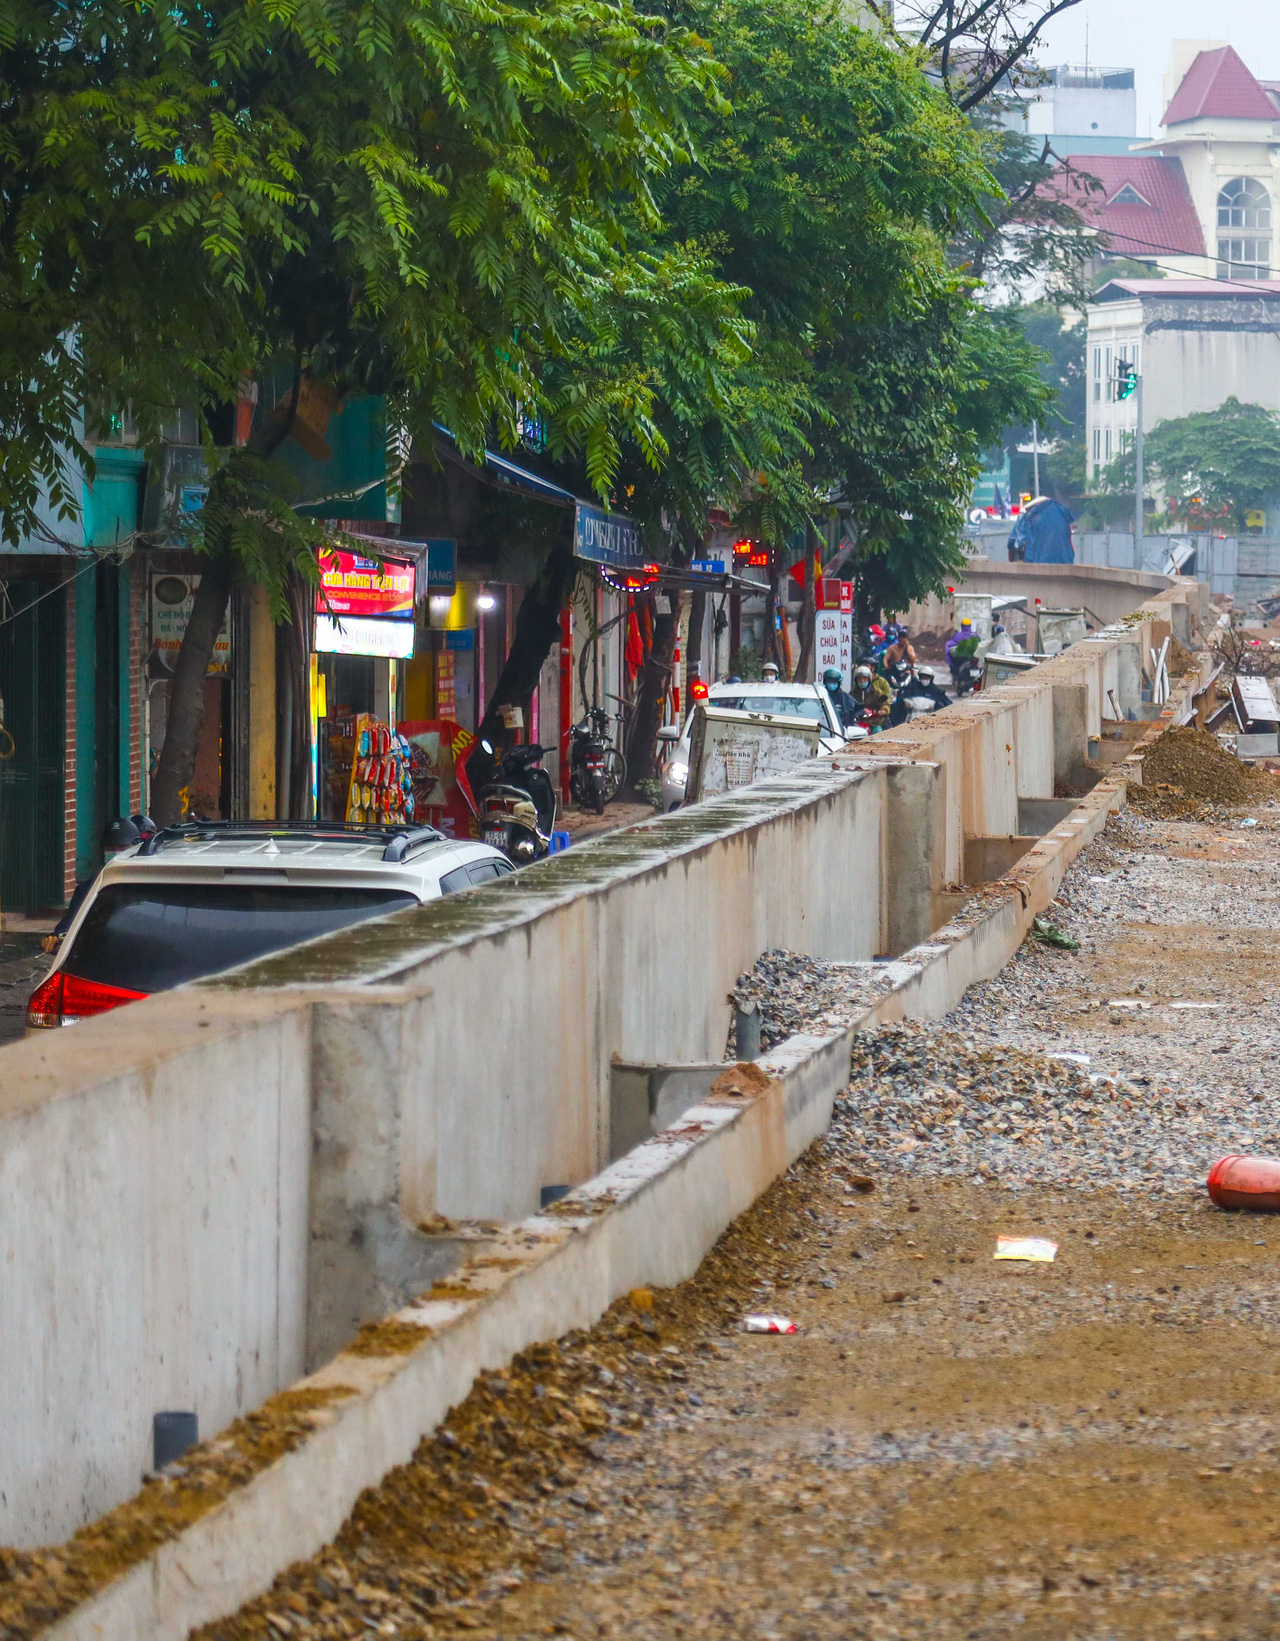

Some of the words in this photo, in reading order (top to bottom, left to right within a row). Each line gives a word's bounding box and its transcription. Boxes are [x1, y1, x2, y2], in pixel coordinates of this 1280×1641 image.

[343, 570, 371, 590] HÀNG
[326, 590, 381, 600] CONVENIENCE
[822, 617, 836, 631] SỬA
[820, 635, 838, 648] CHỮA
